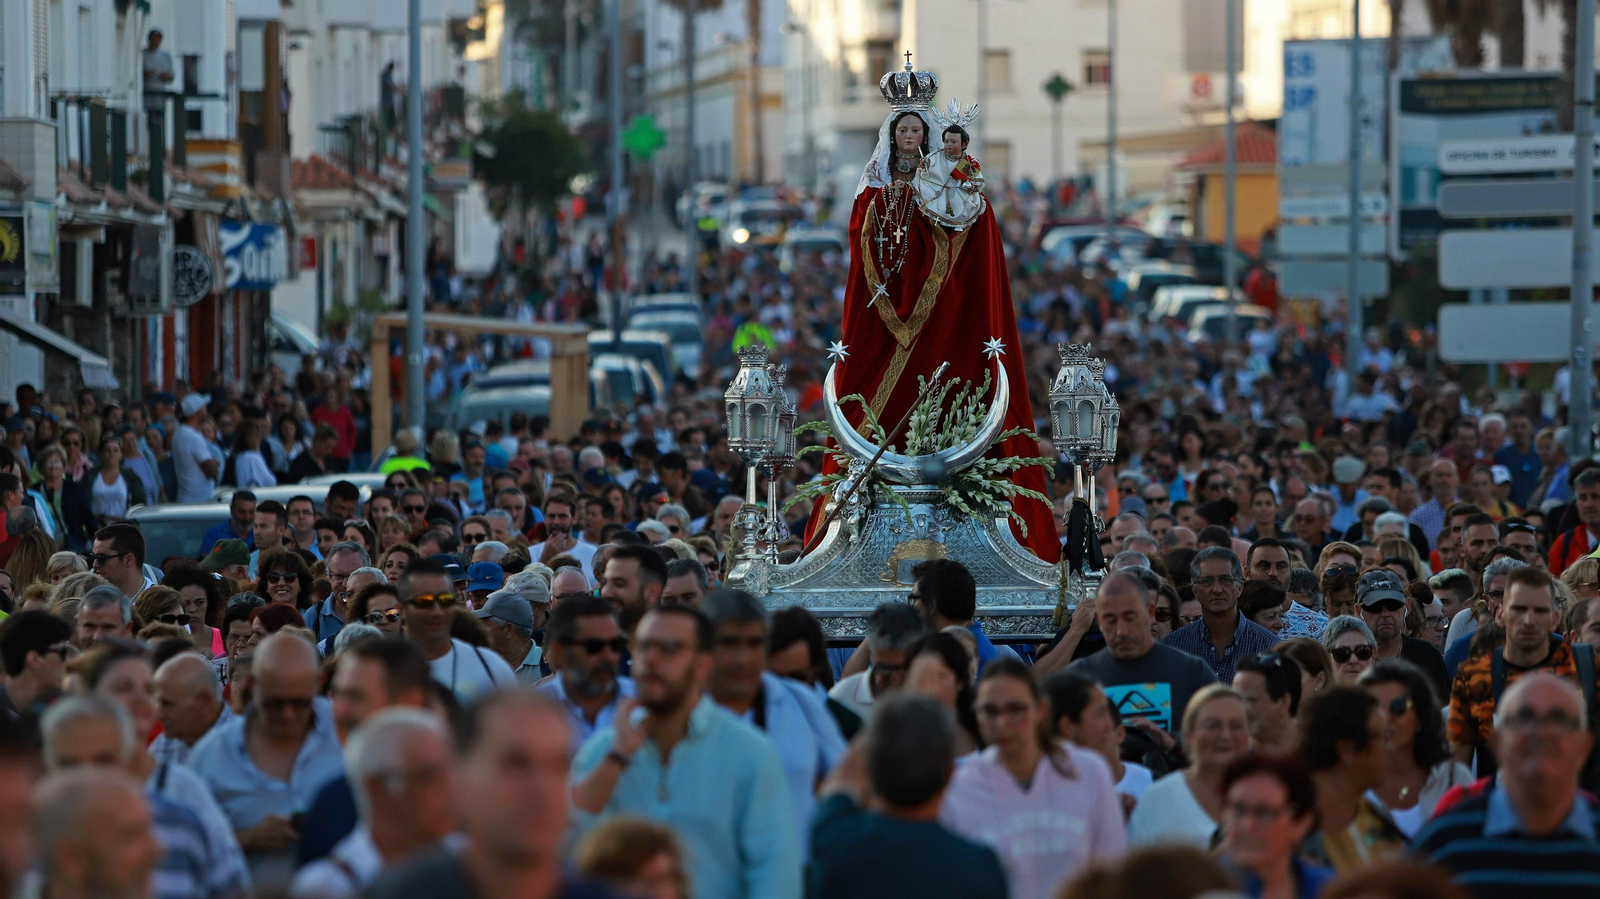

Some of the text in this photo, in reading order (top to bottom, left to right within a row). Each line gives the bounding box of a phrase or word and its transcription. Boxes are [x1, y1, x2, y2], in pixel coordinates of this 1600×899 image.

[1446, 146, 1558, 162] OFICINA DE TURISMO
